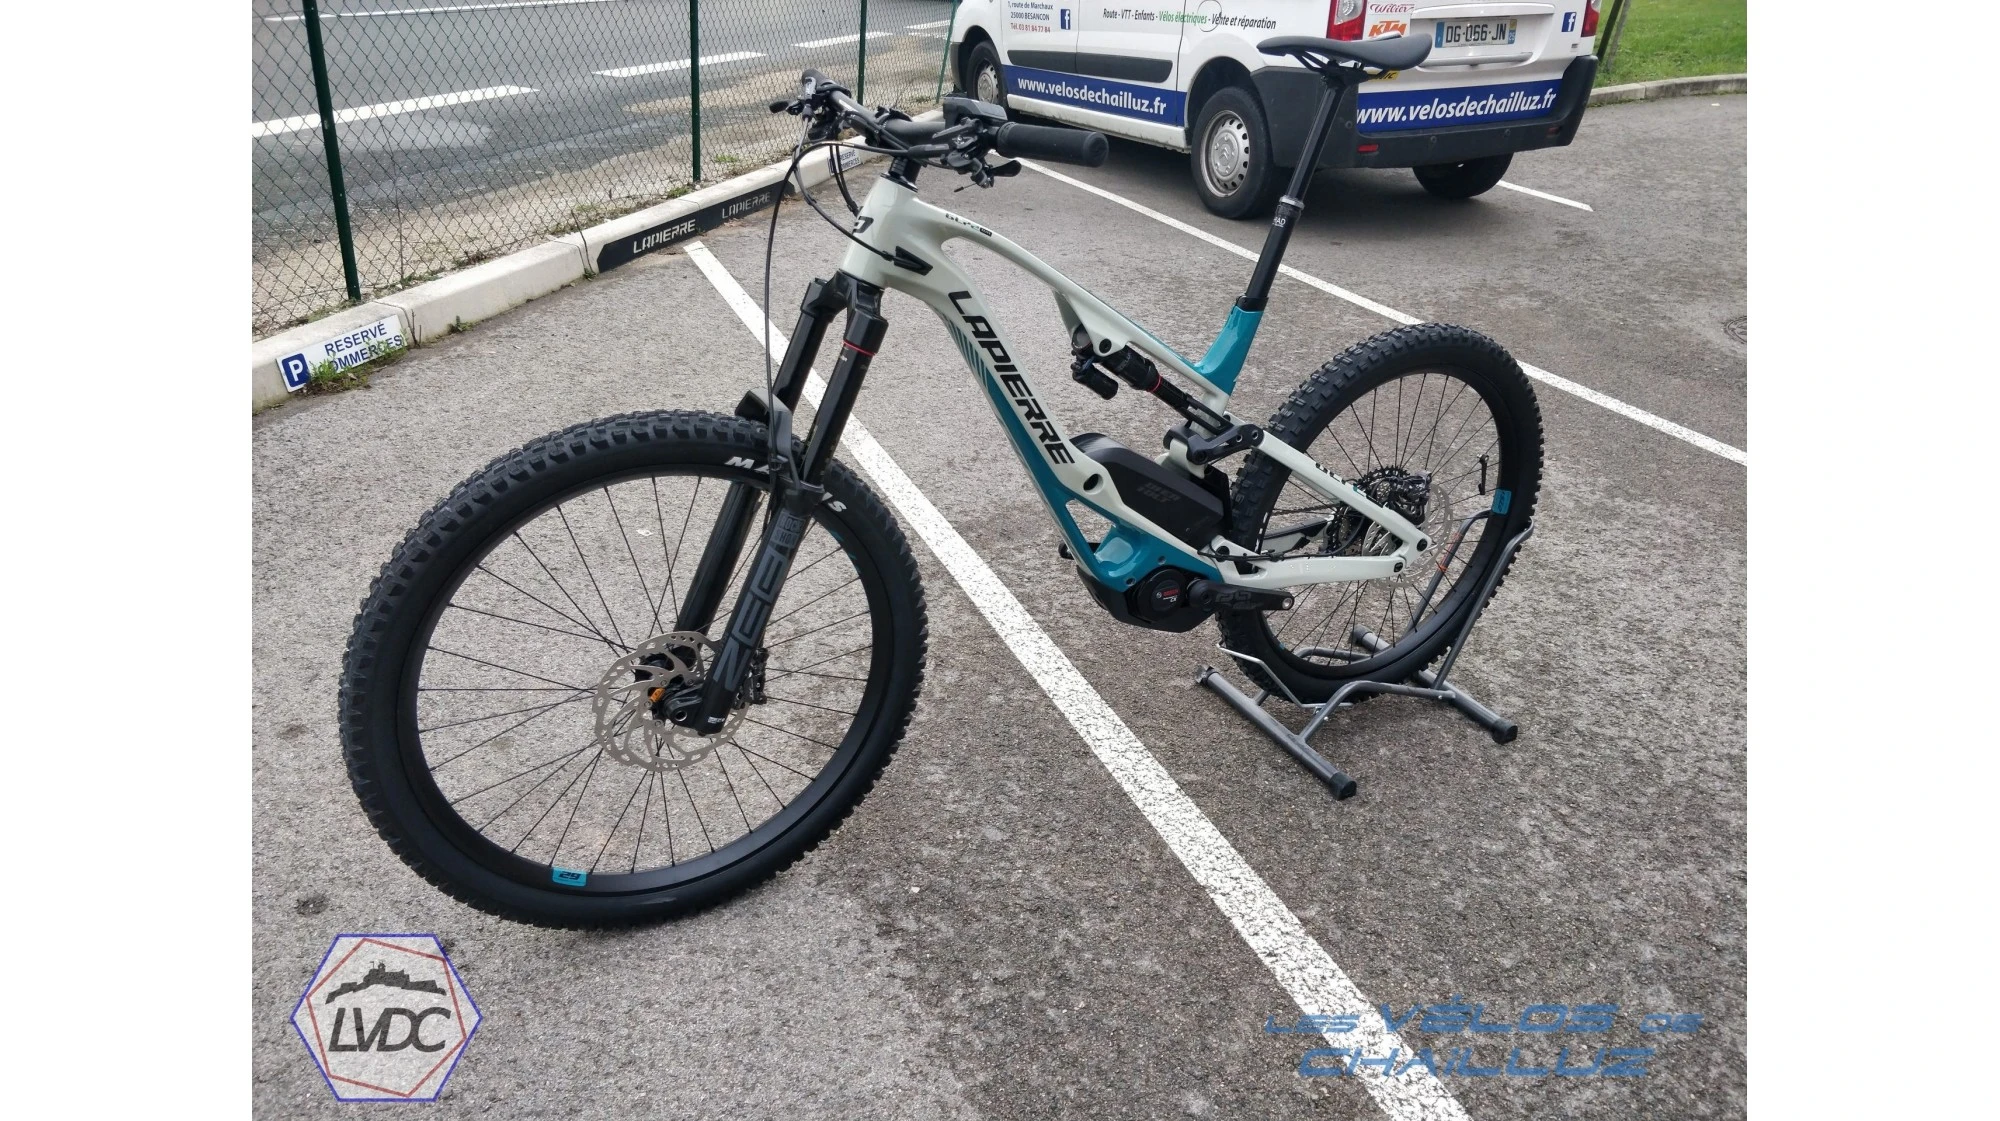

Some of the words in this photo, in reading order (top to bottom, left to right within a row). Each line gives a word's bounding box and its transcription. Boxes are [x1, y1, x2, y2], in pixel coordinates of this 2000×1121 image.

[1031, 2, 1053, 10] Marchaux
[1103, 8, 1118, 19] Route
[1121, 9, 1132, 19] VTT
[1134, 10, 1155, 21] Enfants
[1159, 11, 1174, 22] Vélos
[1175, 12, 1208, 26] électriques
[1212, 13, 1229, 26] Vente
[1229, 16, 1238, 26] et
[1237, 15, 1277, 30] réparation
[1368, 21, 1407, 37] KTM
[1018, 78, 1167, 115] www.velosdechailluz.fr
[1356, 88, 1557, 124] www.velosdechailluz.fr
[722, 192, 771, 219] LAPIERRE
[633, 219, 696, 254] LAPIERRE
[948, 290, 1075, 465] LAPIERRE
[558, 871, 582, 881] 29
